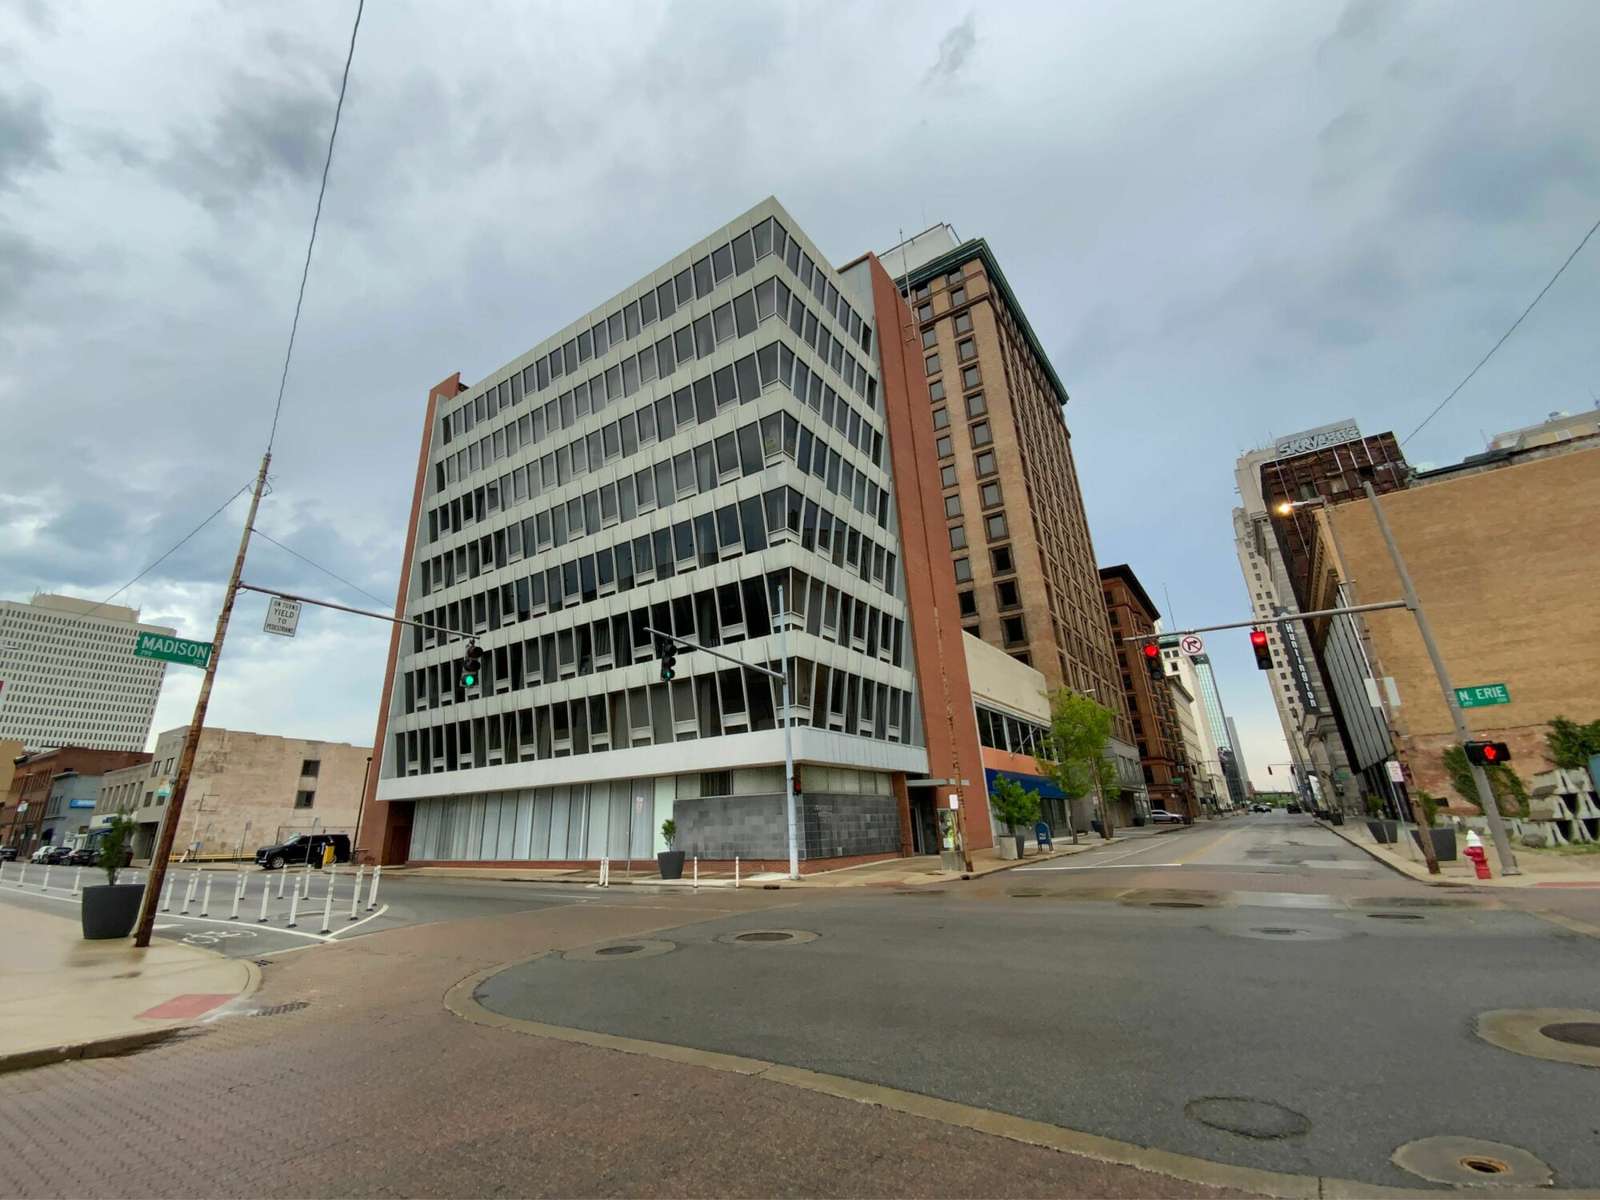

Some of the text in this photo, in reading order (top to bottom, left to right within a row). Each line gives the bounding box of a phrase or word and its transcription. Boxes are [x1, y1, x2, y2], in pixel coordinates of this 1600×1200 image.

[274, 608, 294, 618] YIELD
[142, 636, 208, 658] MADISON
[1285, 623, 1317, 708] Huntington
[1459, 686, 1506, 701] N. ERIE
